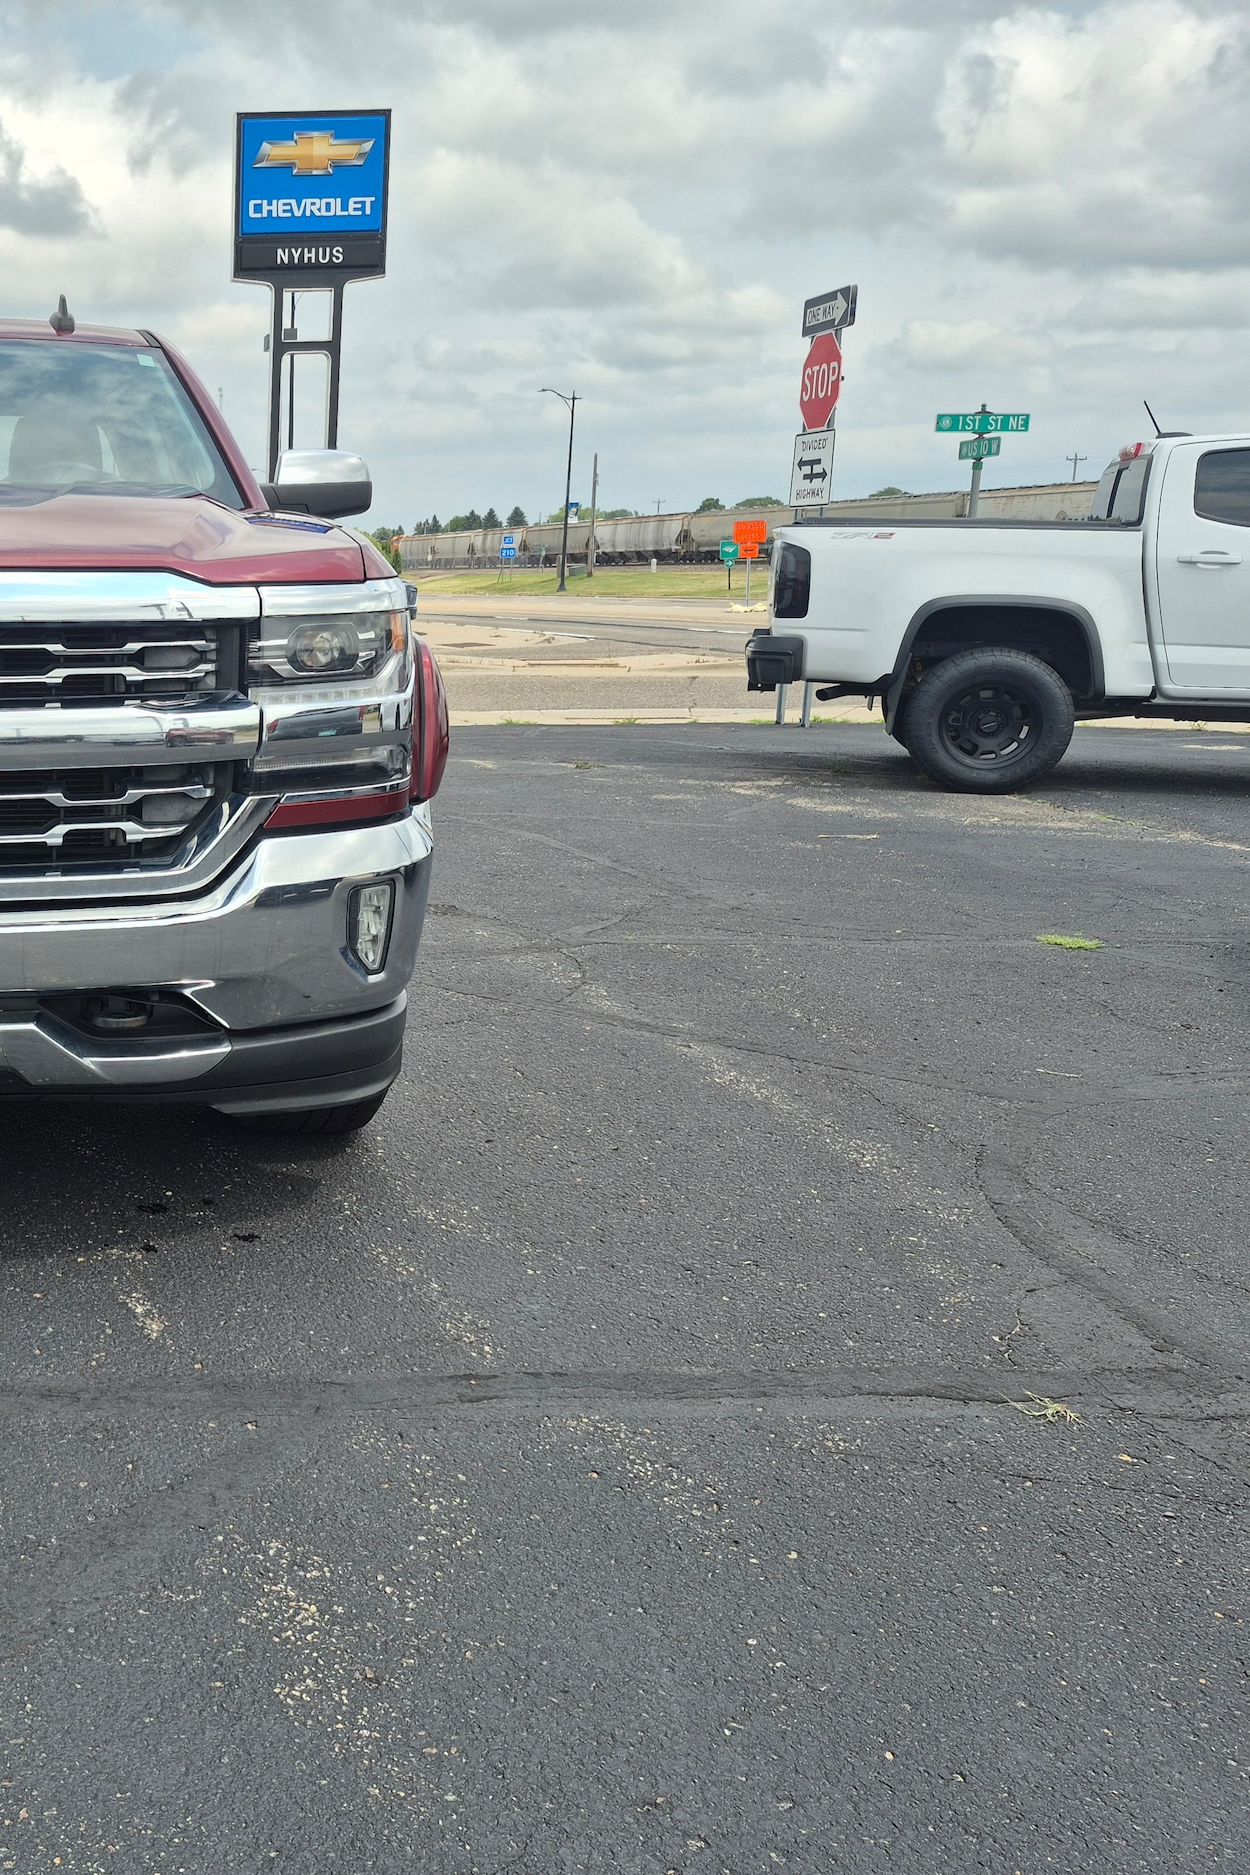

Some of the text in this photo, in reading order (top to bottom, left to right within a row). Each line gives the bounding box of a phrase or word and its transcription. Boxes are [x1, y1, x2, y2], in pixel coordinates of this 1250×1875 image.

[249, 196, 376, 218] CHEVROLET
[276, 246, 344, 265] NYHUS
[807, 302, 837, 325] ONE WAY
[802, 361, 839, 402] STOP
[958, 416, 1027, 430] 1ST ST NE
[802, 439, 827, 452] DIVIDED
[967, 439, 1000, 457] US 10 W
[795, 487, 825, 501] HIGHWAY
[501, 549, 515, 557] 210
